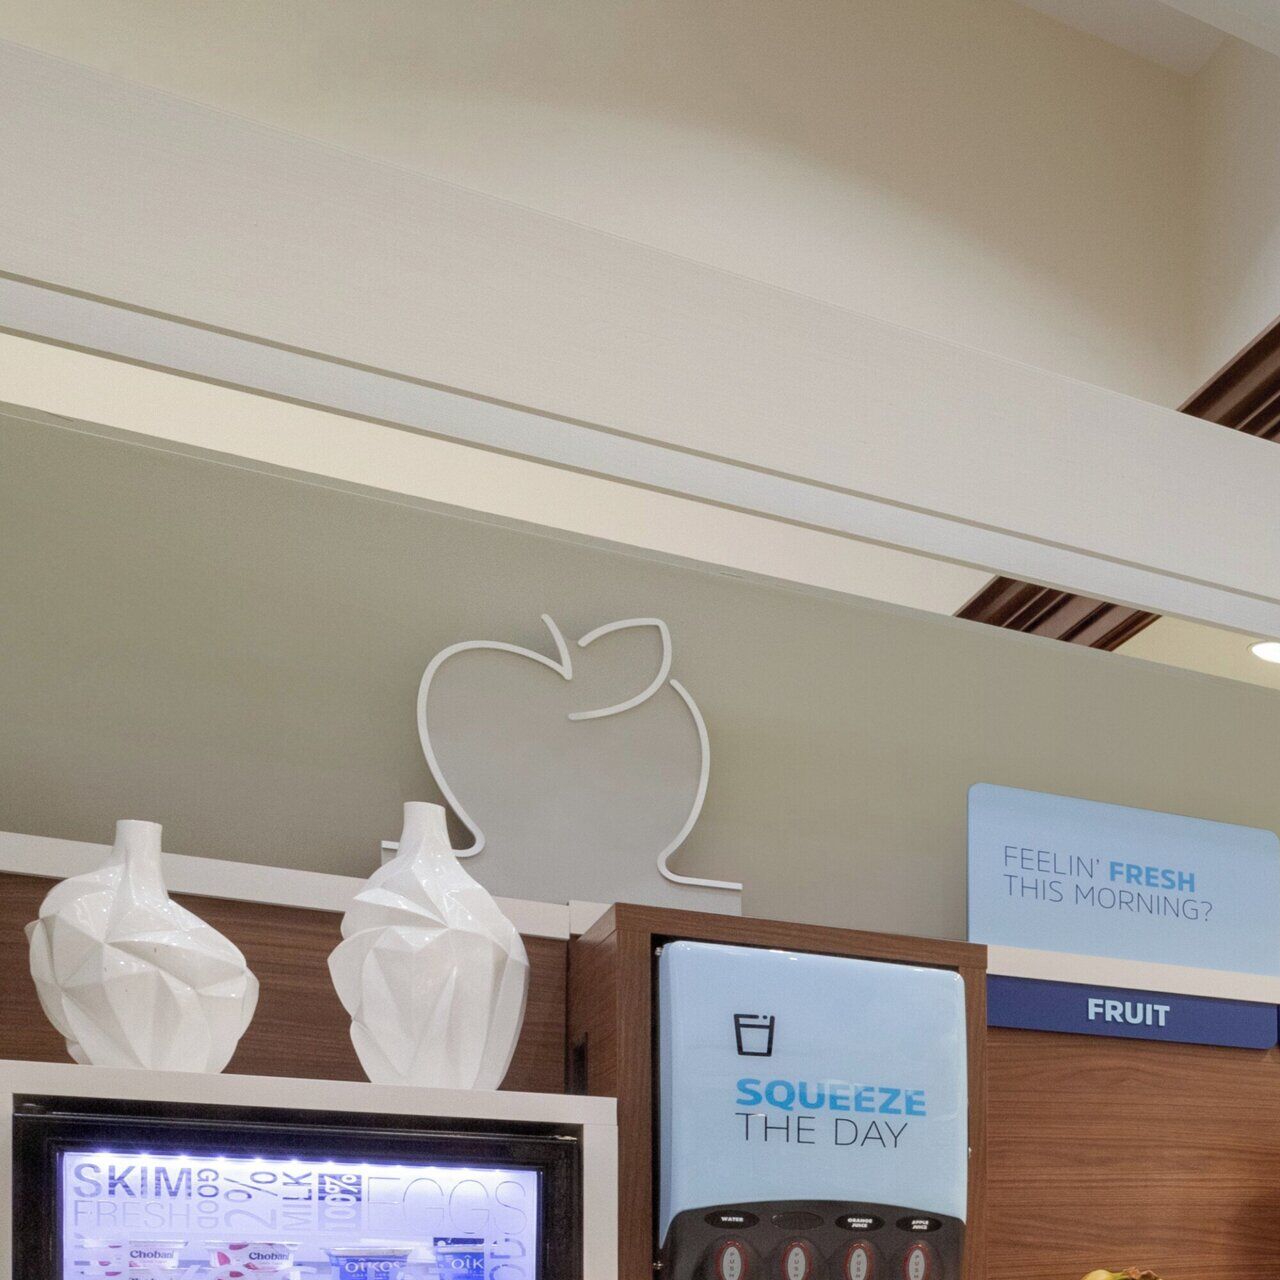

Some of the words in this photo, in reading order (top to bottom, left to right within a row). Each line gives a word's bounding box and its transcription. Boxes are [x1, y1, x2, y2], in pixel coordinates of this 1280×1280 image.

[1109, 860, 1196, 893] FRESH
[1003, 874, 1063, 902] THIS
[1075, 886, 1213, 922] MORNING?
[1088, 998, 1170, 1027] FRUIT
[735, 1077, 927, 1116] SQUEEZE
[735, 1112, 816, 1144] THE
[834, 1118, 908, 1148] DAY
[73, 1163, 193, 1200] SKIM
[74, 1200, 191, 1229] FRESH
[282, 1171, 312, 1231] MILK
[324, 1173, 359, 1231] 100%
[720, 1215, 745, 1223] WATER
[130, 1249, 174, 1259] Chobani
[249, 1251, 290, 1261] Chobani
